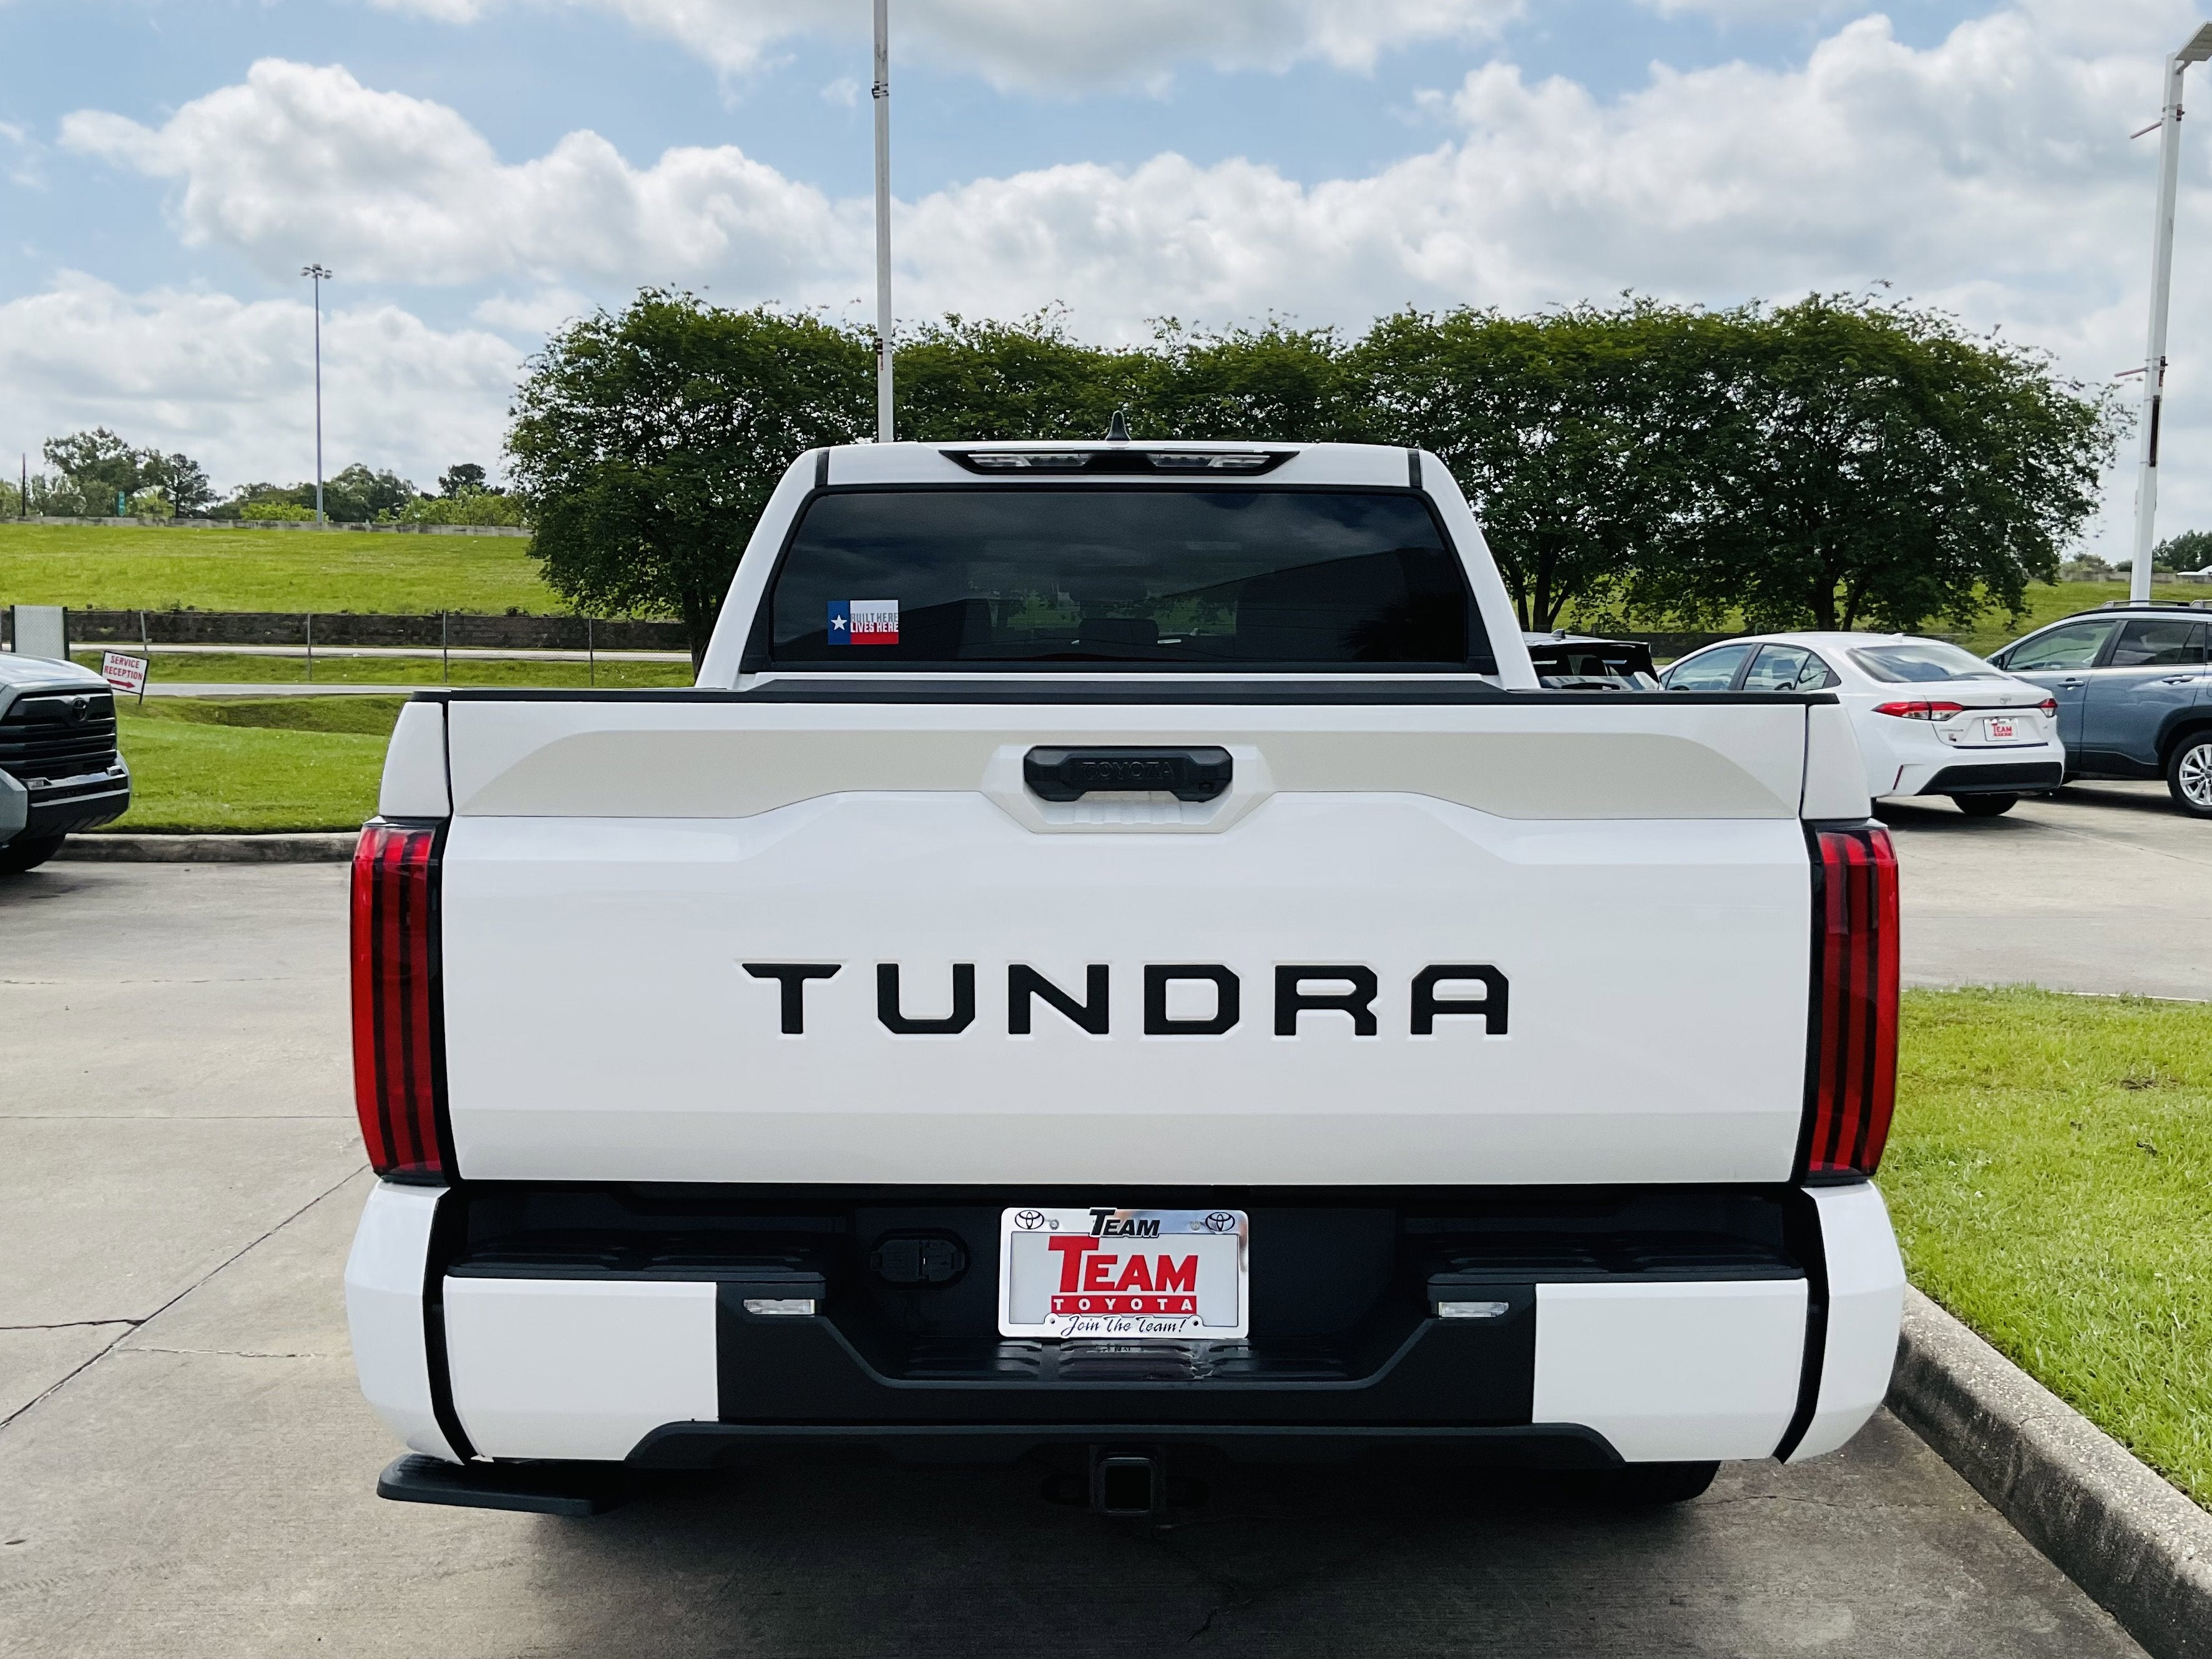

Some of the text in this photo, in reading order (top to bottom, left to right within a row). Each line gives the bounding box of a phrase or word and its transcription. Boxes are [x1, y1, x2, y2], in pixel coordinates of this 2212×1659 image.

[850, 612, 899, 623] BUILT HERE
[850, 622, 899, 633] LIVES HERE
[110, 655, 140, 668] SERVICE
[104, 665, 144, 680] RECEPTION
[1080, 761, 1176, 780] TOYOTA
[741, 963, 1510, 1036] TUNDRA
[1089, 1208, 1161, 1237] TEAM
[1048, 1235, 1198, 1293] TEAM
[1053, 1298, 1193, 1311] TOYOTA
[1060, 1315, 1187, 1337] Join The Team!
